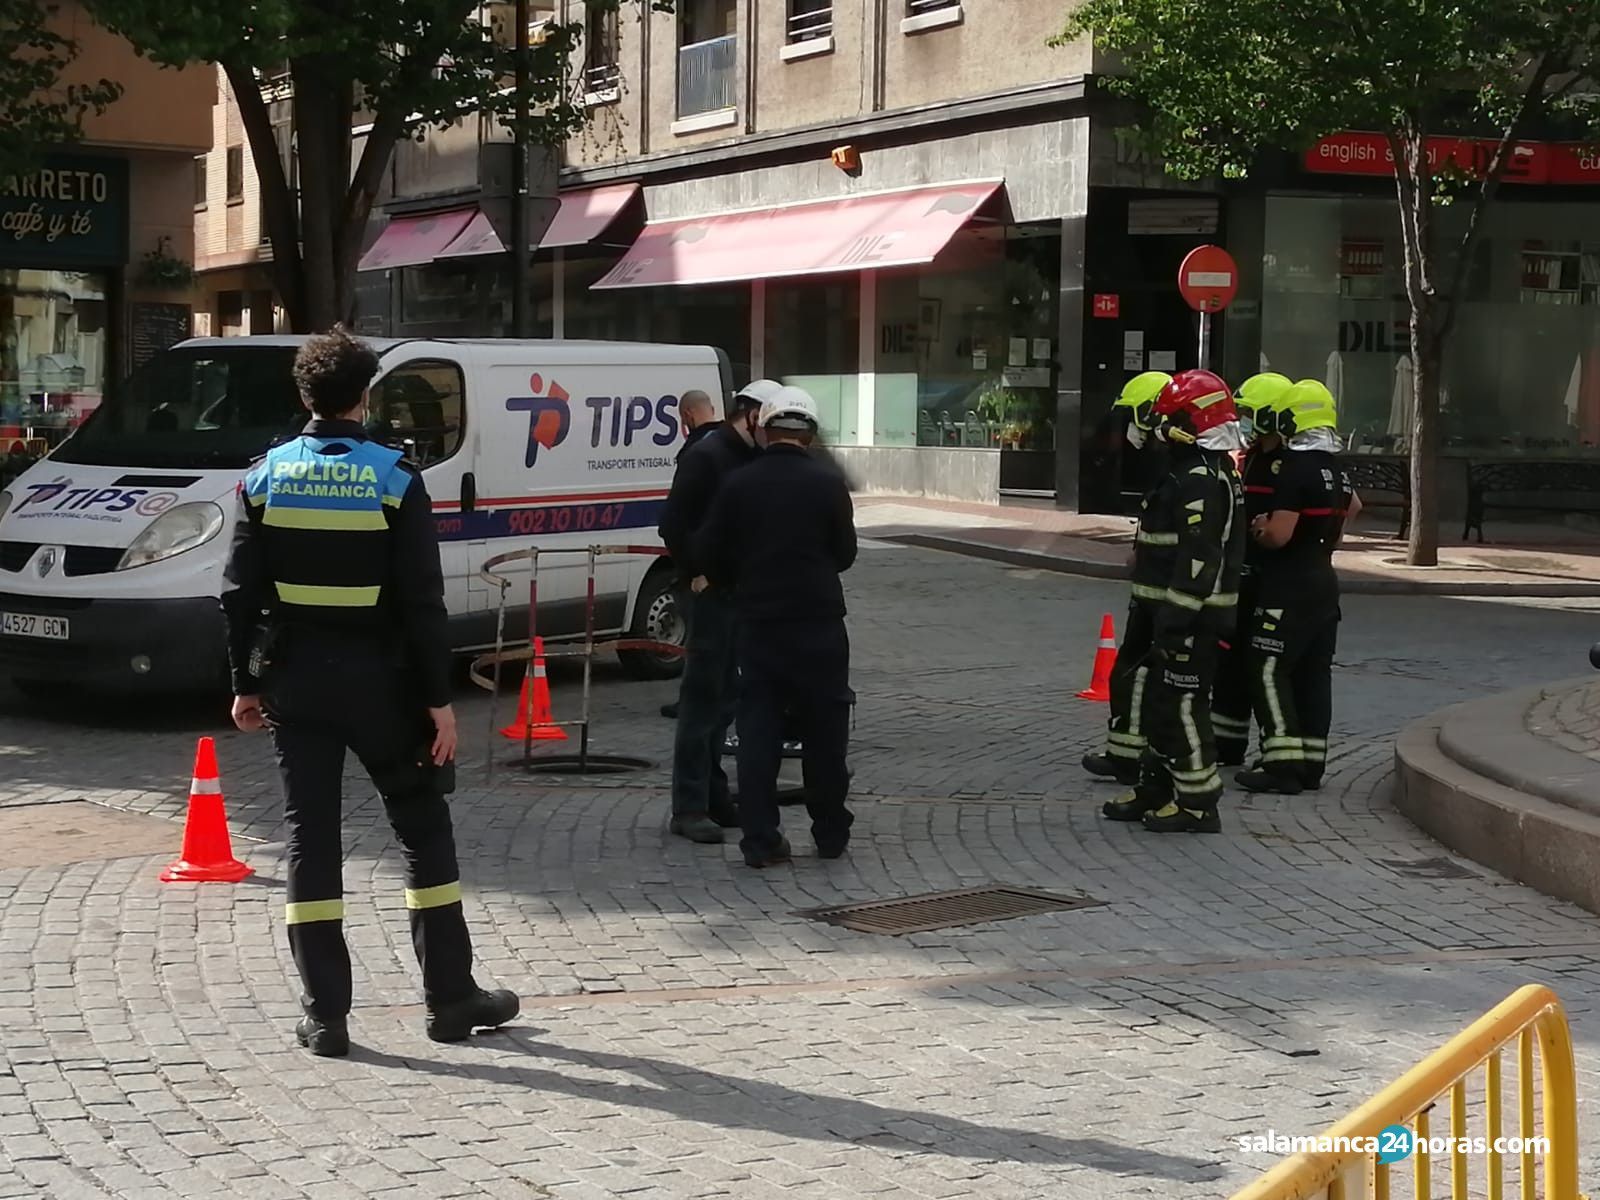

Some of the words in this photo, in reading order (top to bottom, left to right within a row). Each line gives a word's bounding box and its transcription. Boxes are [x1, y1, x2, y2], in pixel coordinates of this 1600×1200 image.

[1320, 142, 1376, 163] english
[1385, 147, 1437, 165] shol
[2, 202, 44, 240] café
[47, 214, 66, 242] y
[71, 209, 92, 234] té
[585, 394, 688, 448] TIPS
[273, 459, 378, 484] POLICIA
[587, 459, 636, 472] TRANSPORTE
[637, 457, 672, 469] INTEGRAL
[53, 487, 179, 517] TIPS@
[271, 481, 377, 499] SALAMANCA
[508, 509, 545, 534] 902
[550, 507, 570, 532] 10
[576, 506, 596, 530] 10
[600, 503, 625, 528] 47
[4, 615, 36, 633] 4527
[43, 618, 67, 637] GCW
